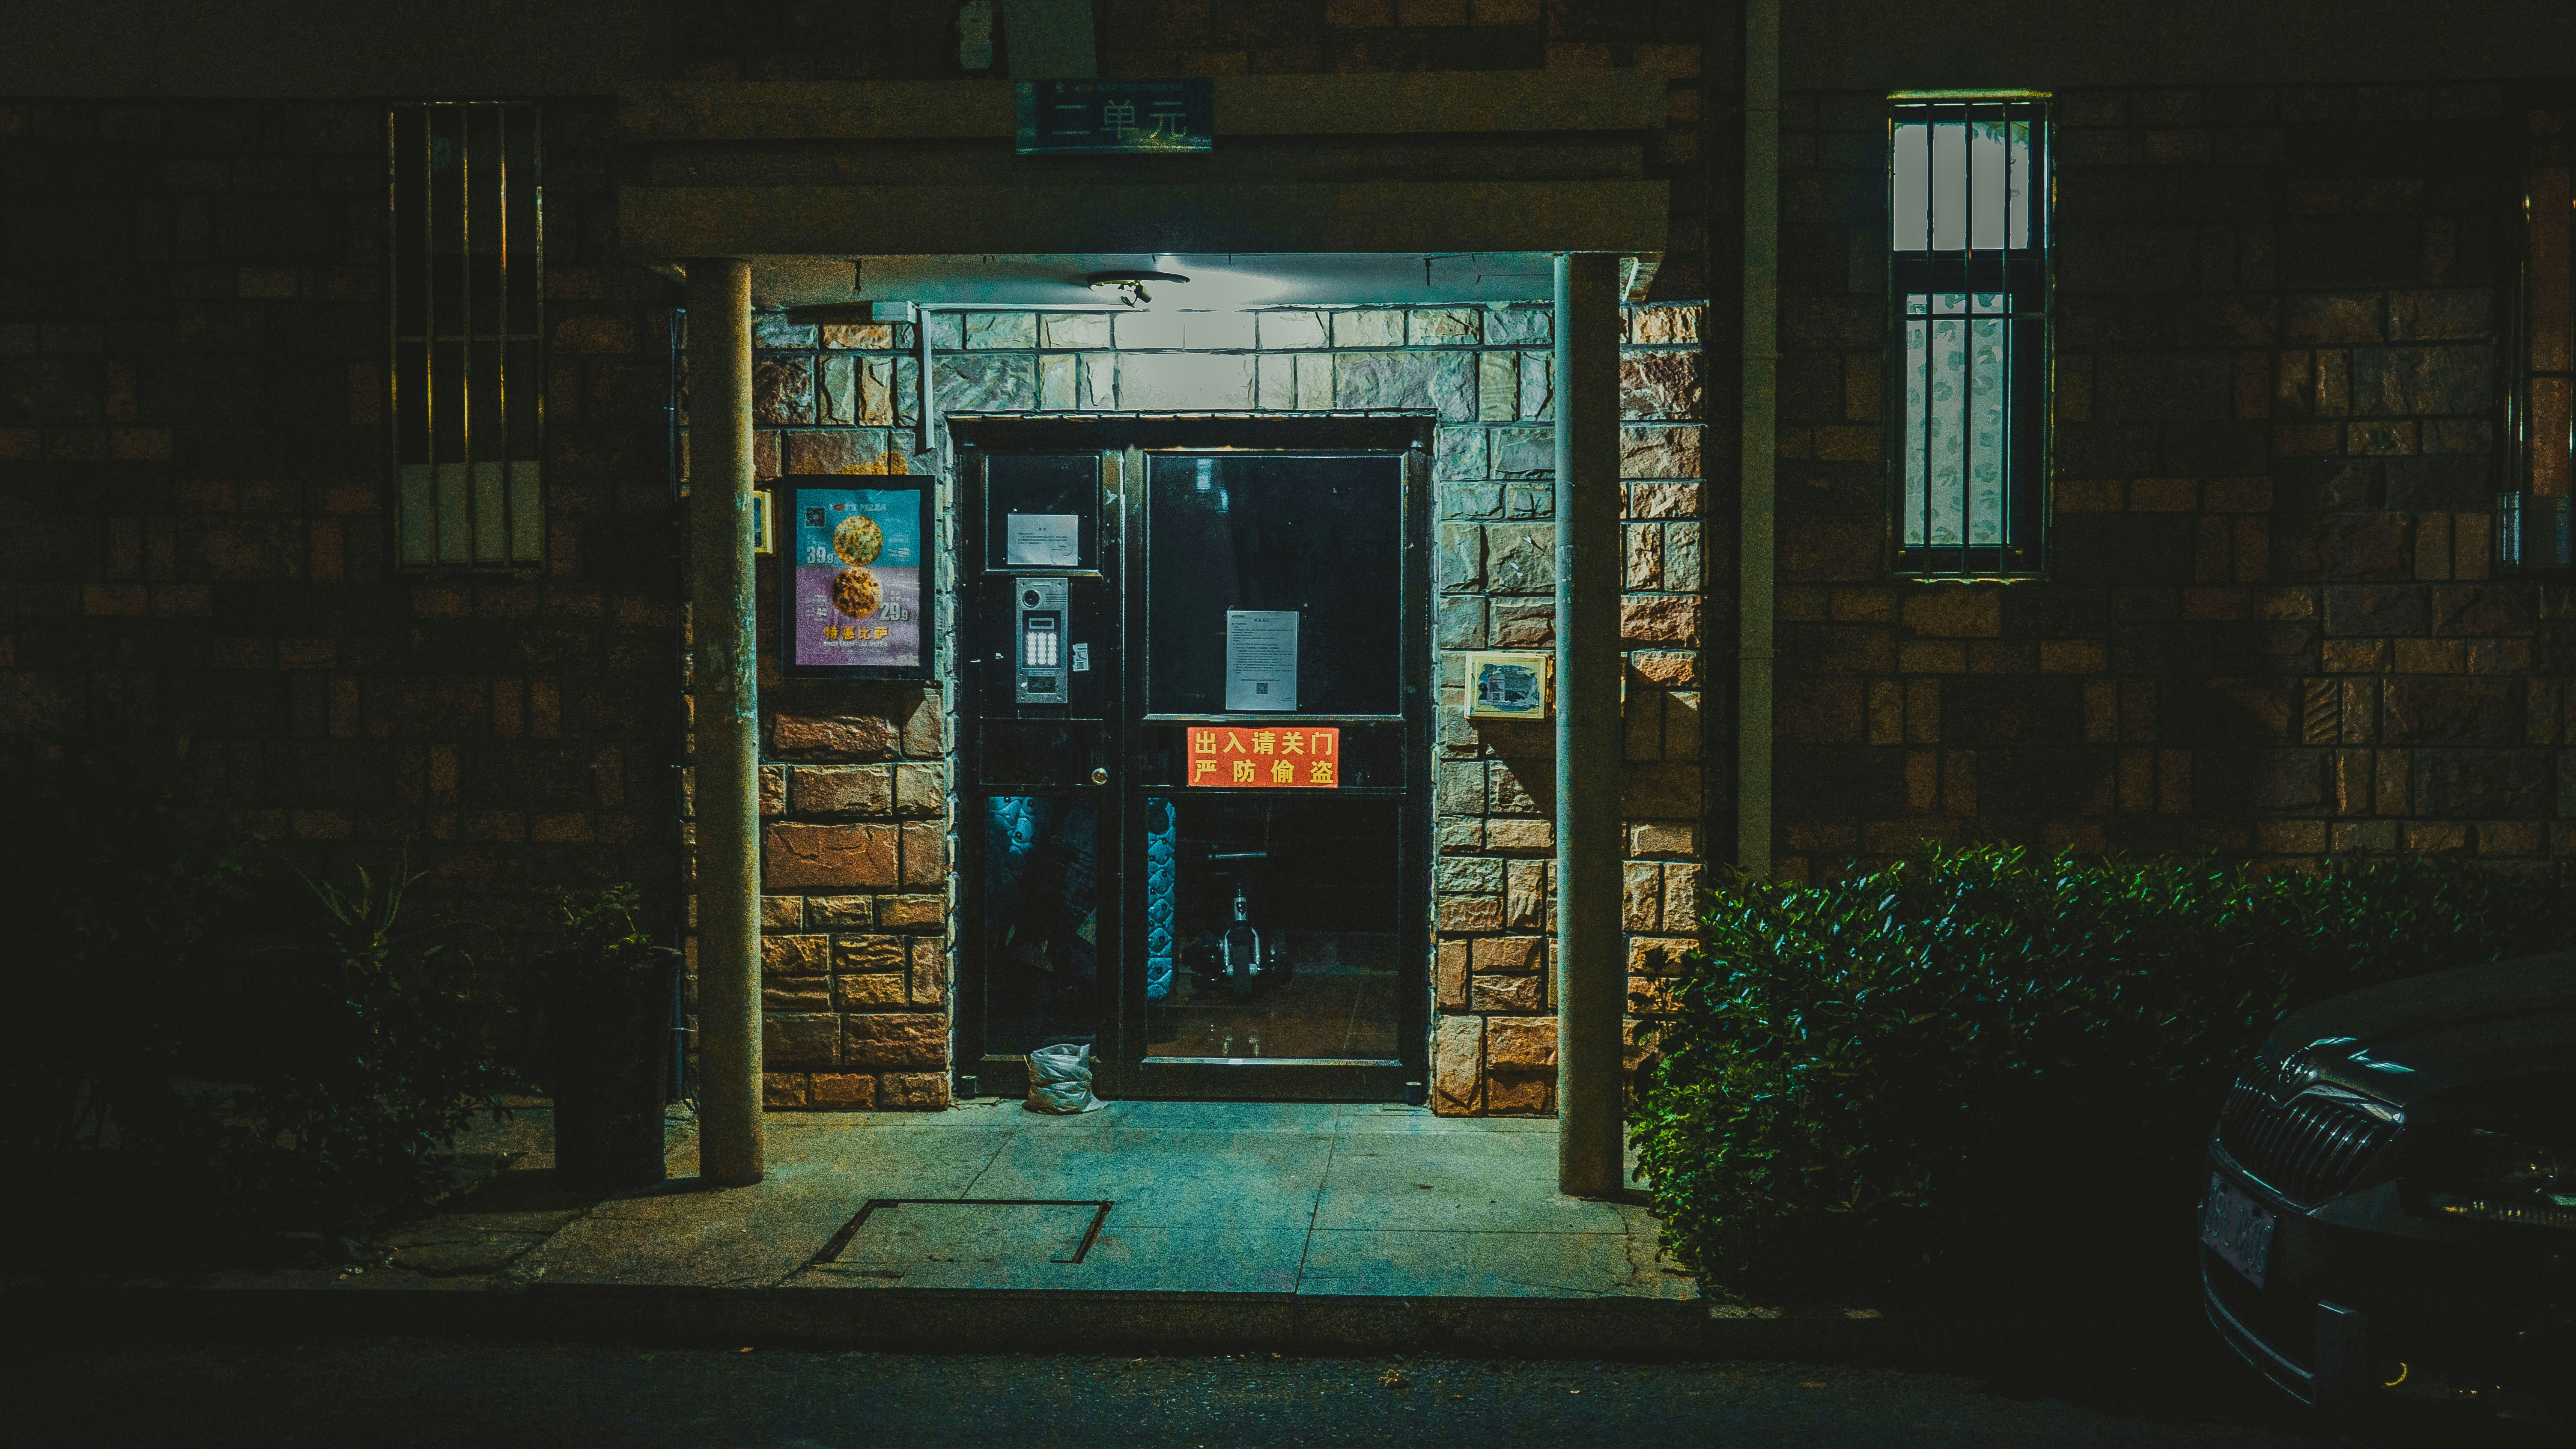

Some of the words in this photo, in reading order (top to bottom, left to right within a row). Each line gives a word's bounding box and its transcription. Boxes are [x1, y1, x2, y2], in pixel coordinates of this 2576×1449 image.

[1052, 99, 1187, 139] 二单元
[806, 546, 835, 564] 39.9
[879, 602, 908, 620] 29.9
[824, 625, 888, 641] 特惠比萨
[1195, 730, 1333, 755] 出入请关门
[1194, 759, 1333, 783] 严防偷盗
